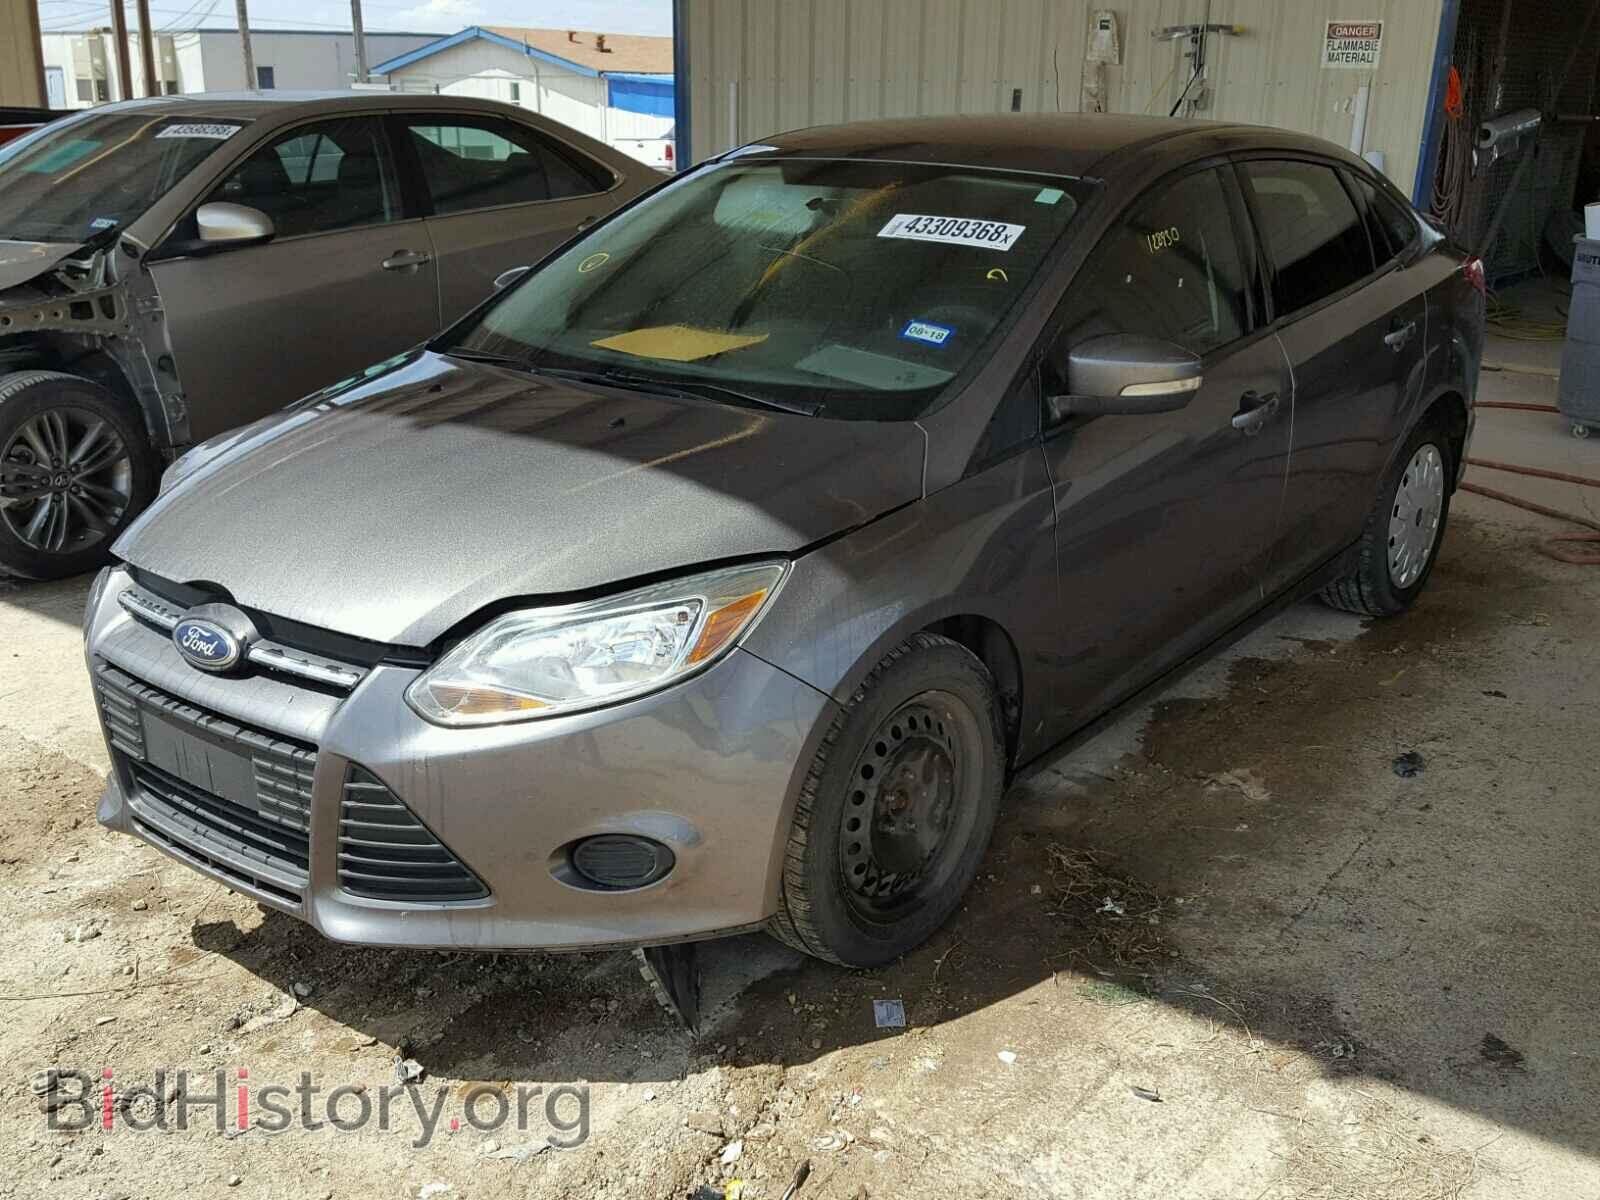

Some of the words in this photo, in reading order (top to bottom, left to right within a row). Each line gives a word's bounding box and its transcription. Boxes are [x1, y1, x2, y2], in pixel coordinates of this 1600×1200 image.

[1335, 26, 1376, 36] DANGER
[1327, 40, 1378, 51] FLAMMABLE
[183, 626, 218, 656] Ford
